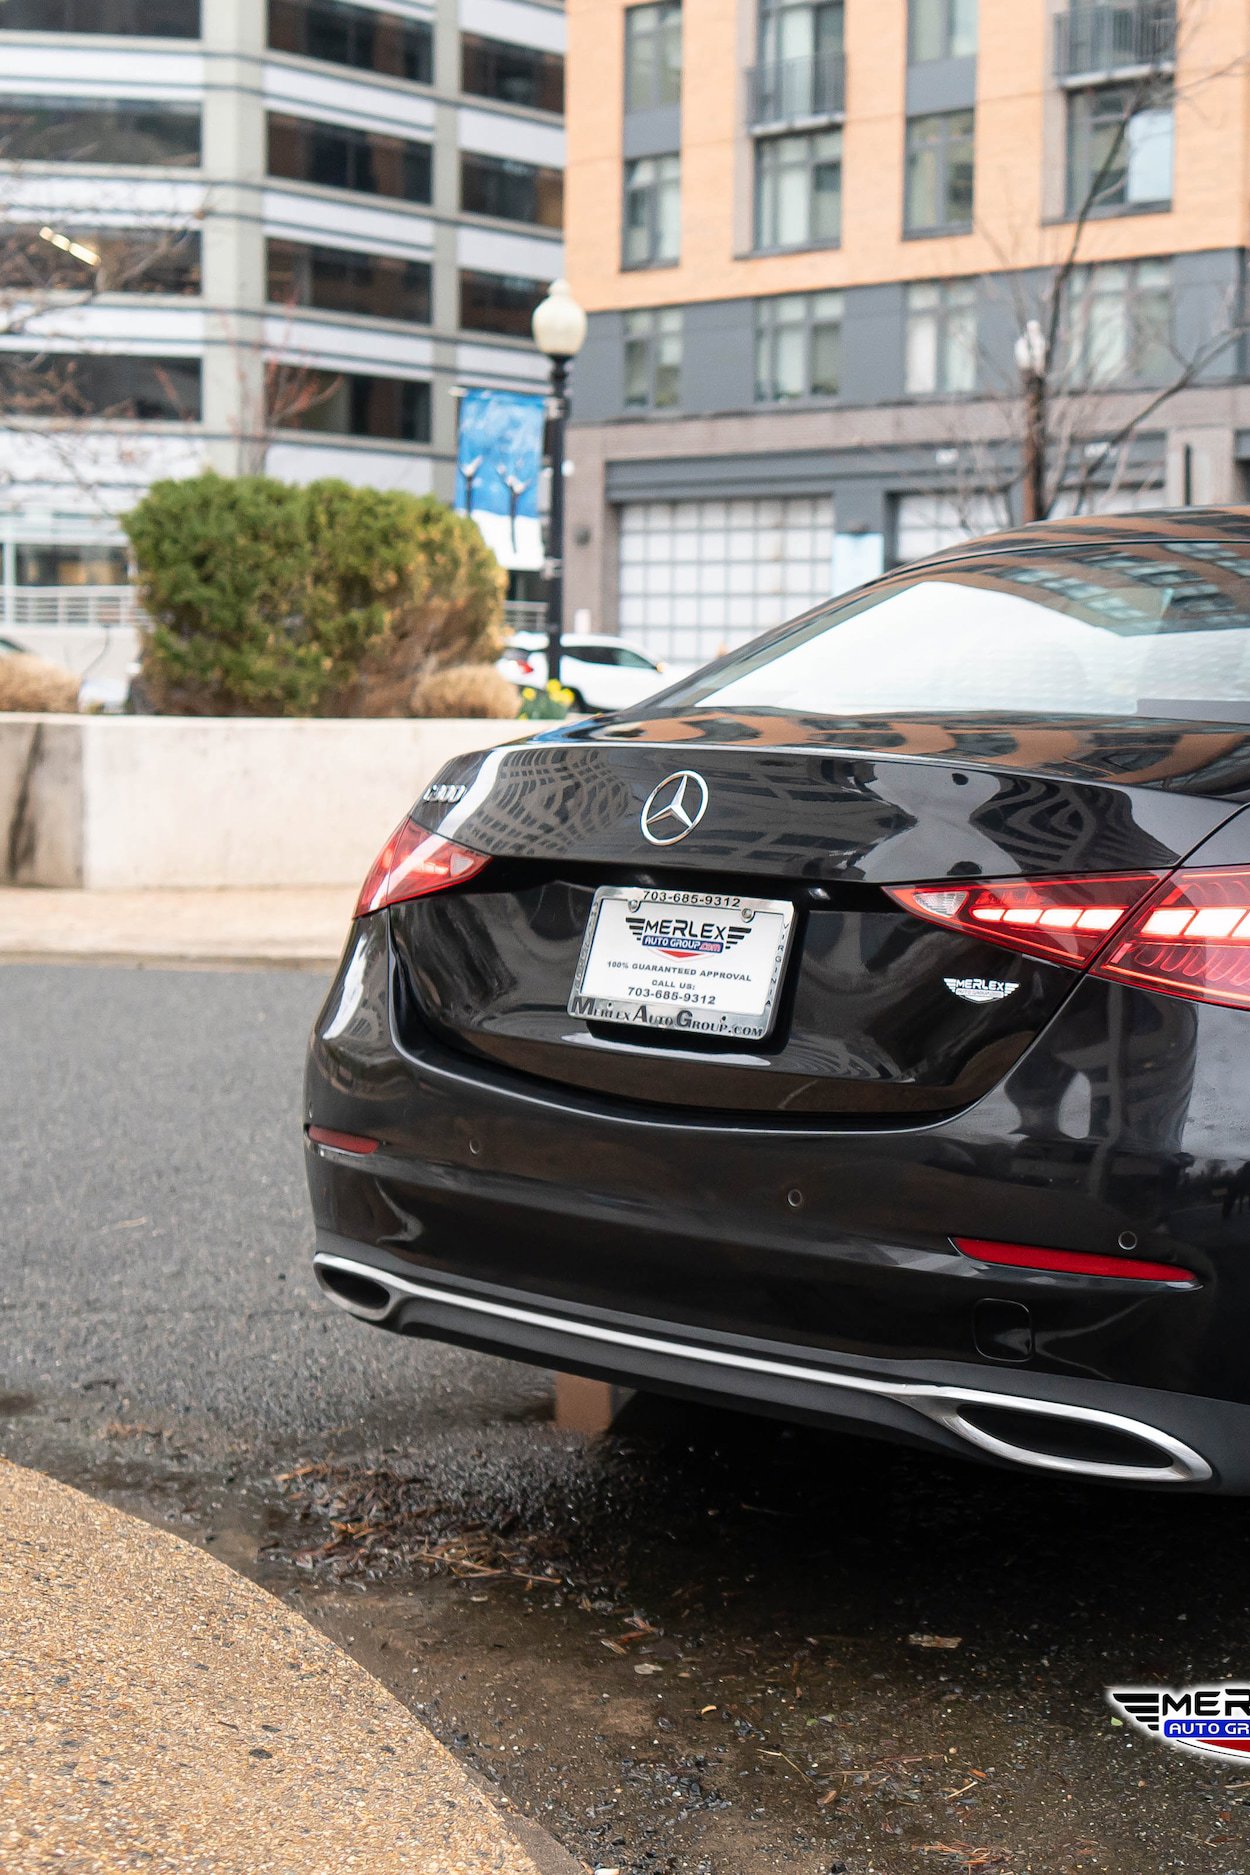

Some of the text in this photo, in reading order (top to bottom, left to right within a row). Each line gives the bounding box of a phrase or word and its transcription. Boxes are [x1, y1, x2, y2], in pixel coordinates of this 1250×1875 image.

[643, 890, 741, 908] 703-685-9312
[644, 919, 727, 940] MERLEX
[645, 936, 669, 947] AUTO
[607, 961, 752, 982] 100% GUARANTEED APPROVAL
[651, 979, 696, 991] CALL US:
[956, 979, 1004, 990] MERLEX
[627, 986, 716, 1005] 703-685-9312
